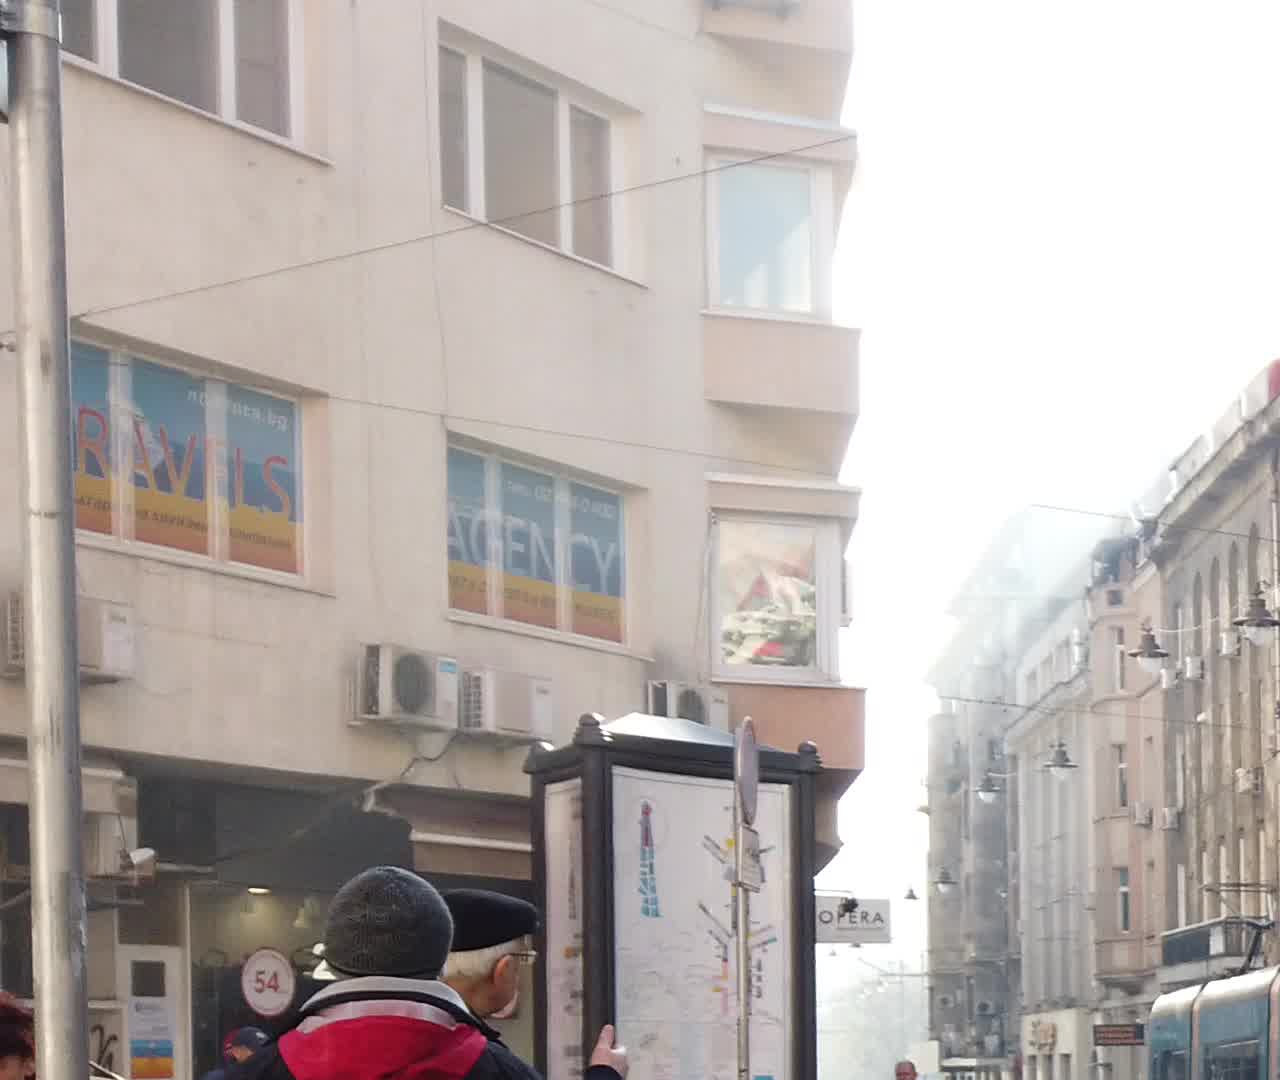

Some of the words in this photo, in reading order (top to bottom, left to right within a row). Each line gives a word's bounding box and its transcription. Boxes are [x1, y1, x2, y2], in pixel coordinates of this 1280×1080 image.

[77, 404, 292, 515] RAVELS
[818, 909, 884, 925] OPERA
[254, 969, 281, 993] 54
